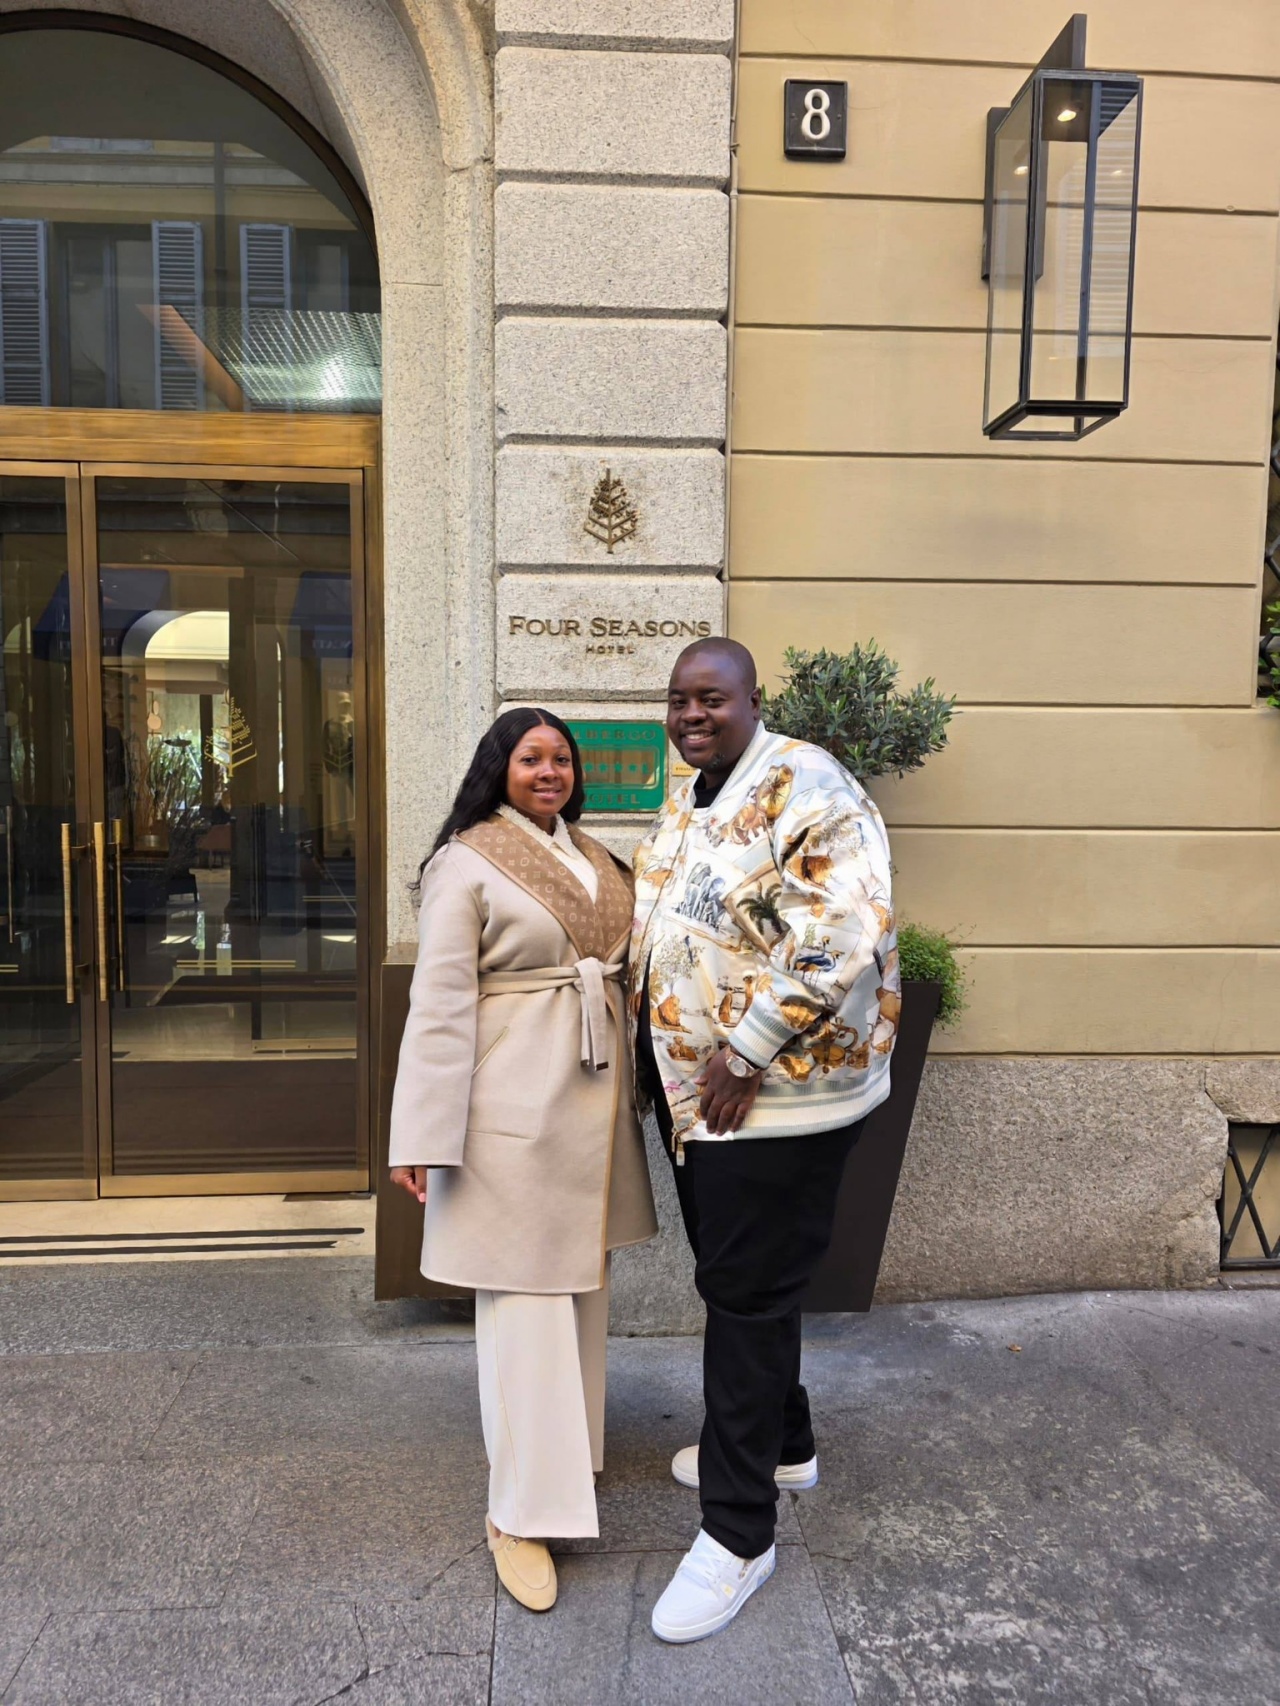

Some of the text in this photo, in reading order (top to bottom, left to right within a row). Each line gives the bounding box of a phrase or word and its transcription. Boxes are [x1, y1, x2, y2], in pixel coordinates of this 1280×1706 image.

[801, 88, 831, 140] 8
[508, 615, 711, 638] FOUR SEASONS
[585, 643, 635, 655] HOTEL
[573, 729, 656, 741] LBERGO
[583, 793, 640, 804] OTEL
